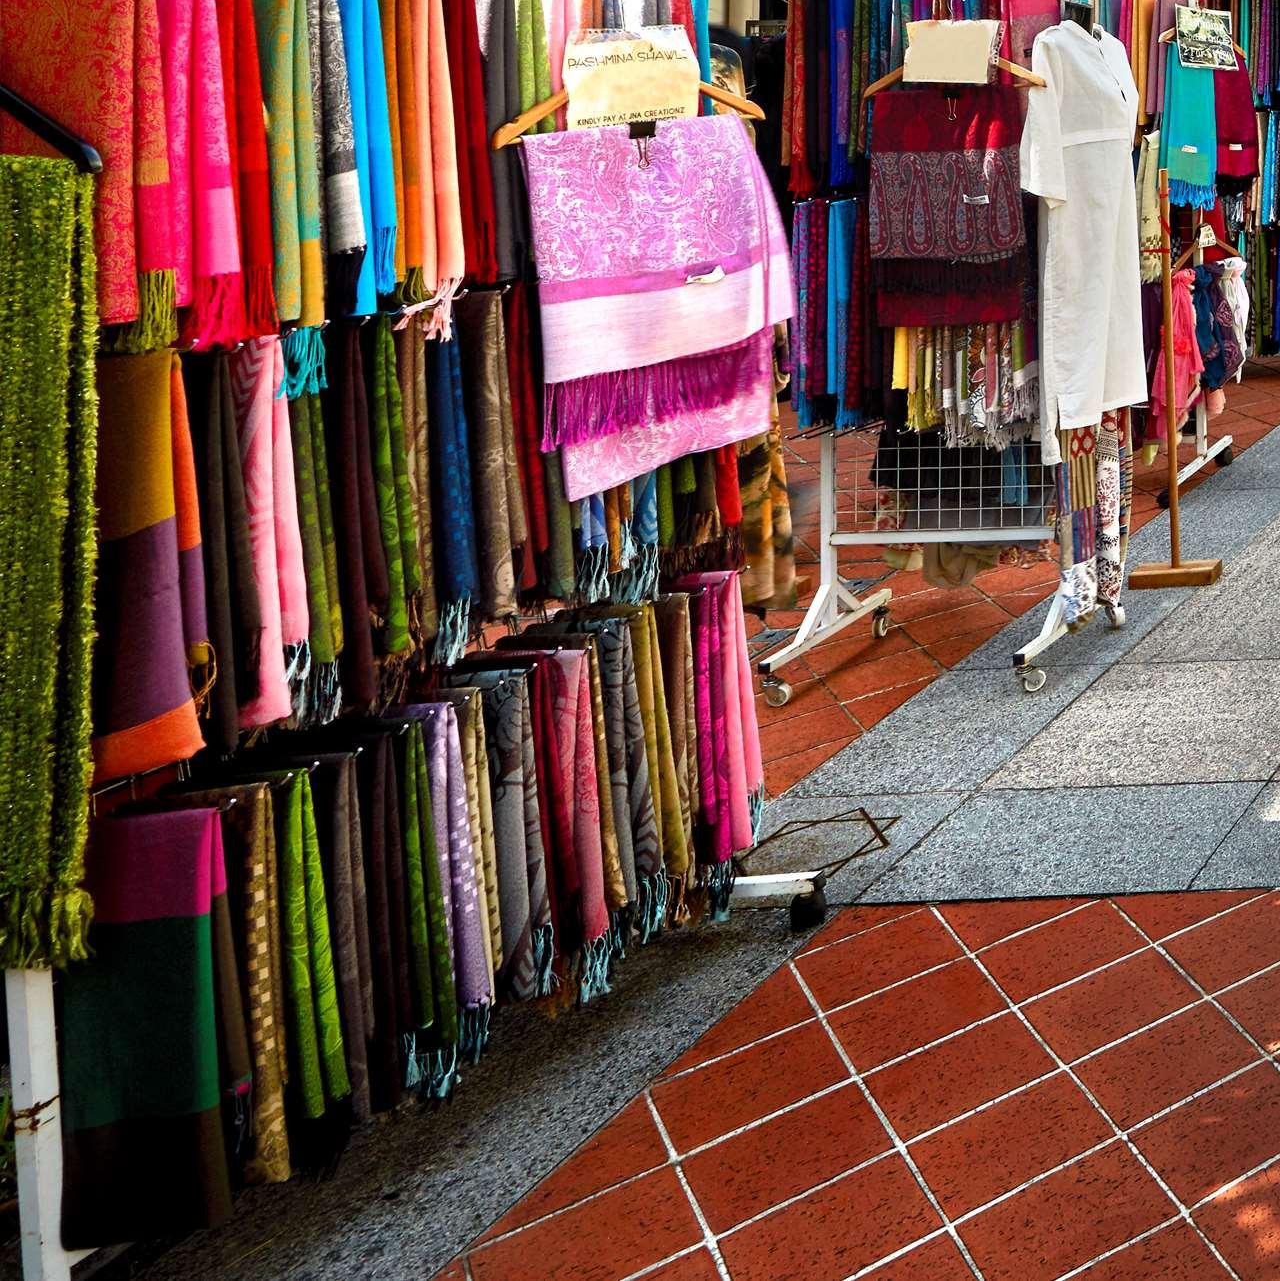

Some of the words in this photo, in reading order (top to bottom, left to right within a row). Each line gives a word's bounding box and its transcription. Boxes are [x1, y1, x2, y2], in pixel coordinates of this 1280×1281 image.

[567, 52, 634, 69] PASHMINA
[577, 117, 602, 126] KINDLY
[602, 114, 617, 122] PAY
[618, 113, 628, 121] AT
[643, 106, 686, 118] CREATIONZ
